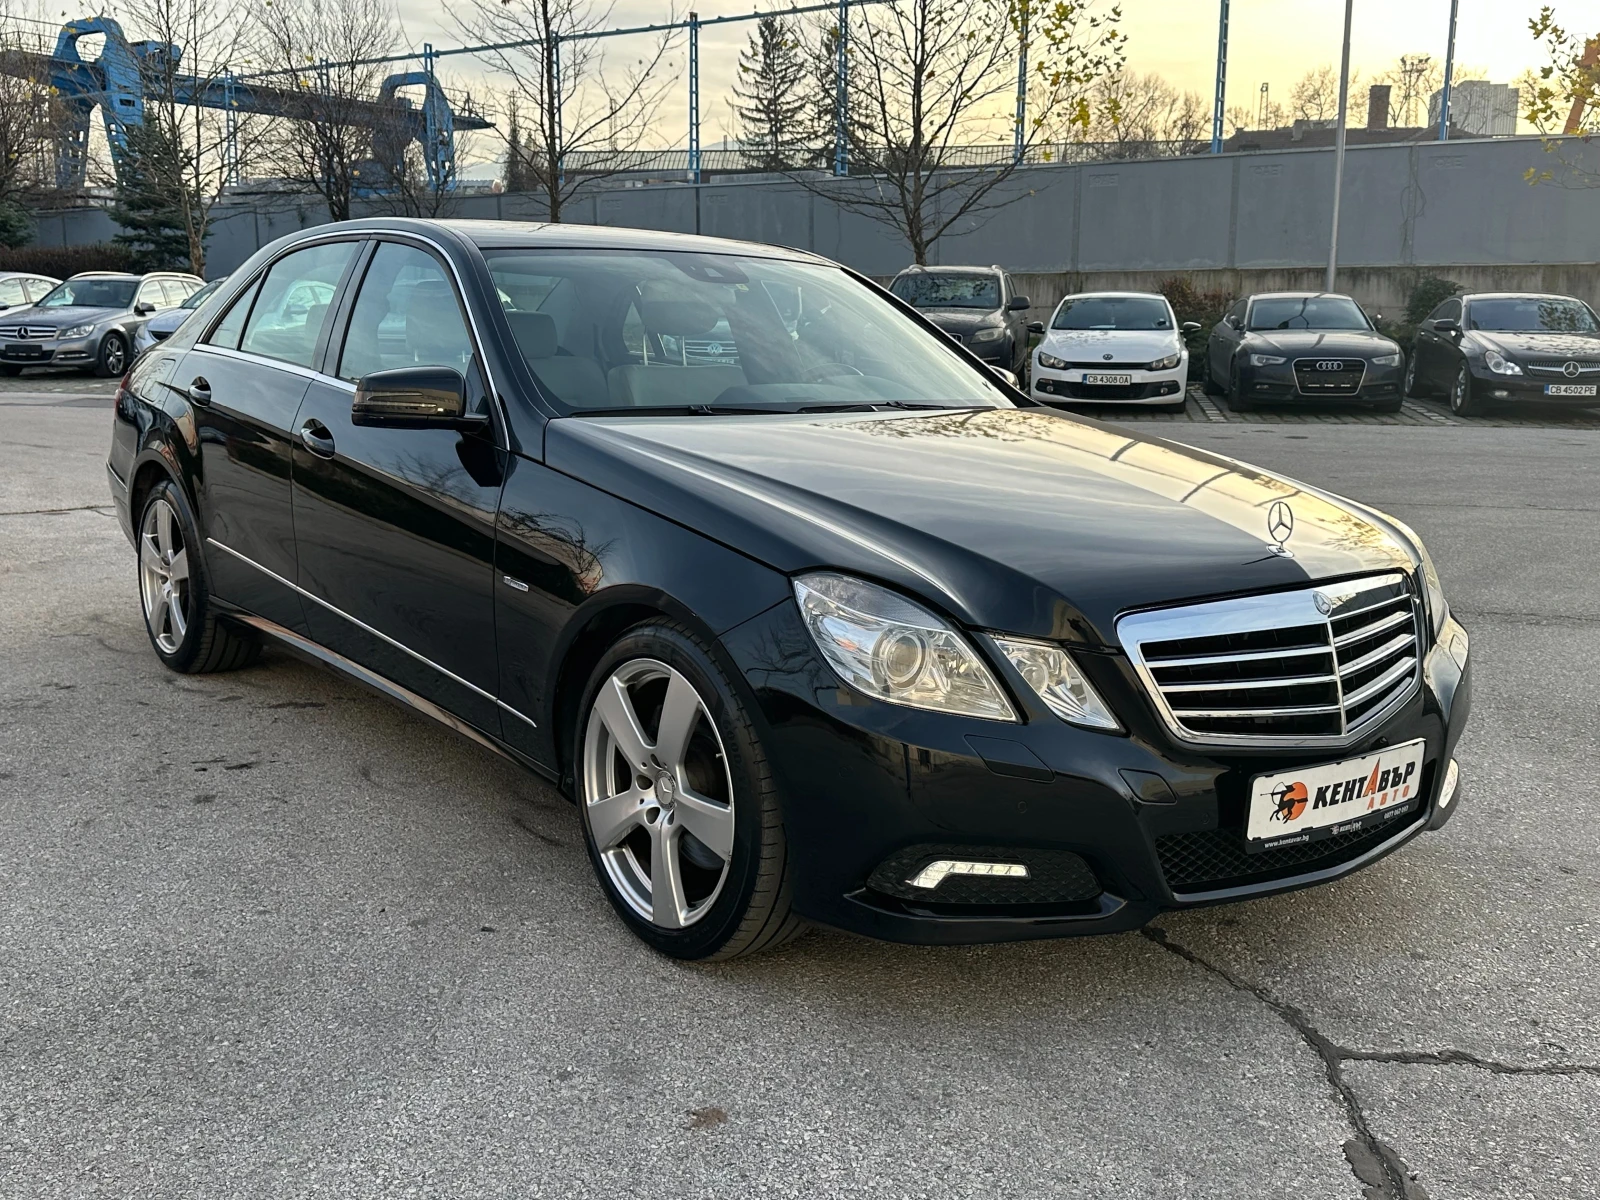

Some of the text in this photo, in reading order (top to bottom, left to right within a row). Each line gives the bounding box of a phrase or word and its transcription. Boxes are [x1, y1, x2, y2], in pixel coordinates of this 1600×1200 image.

[1099, 375, 1118, 384] 4308
[1563, 386, 1583, 394] 4502
[1585, 386, 1595, 394] PE
[1312, 757, 1416, 810] КЕНТАВЪР
[1367, 785, 1410, 810] АВТО
